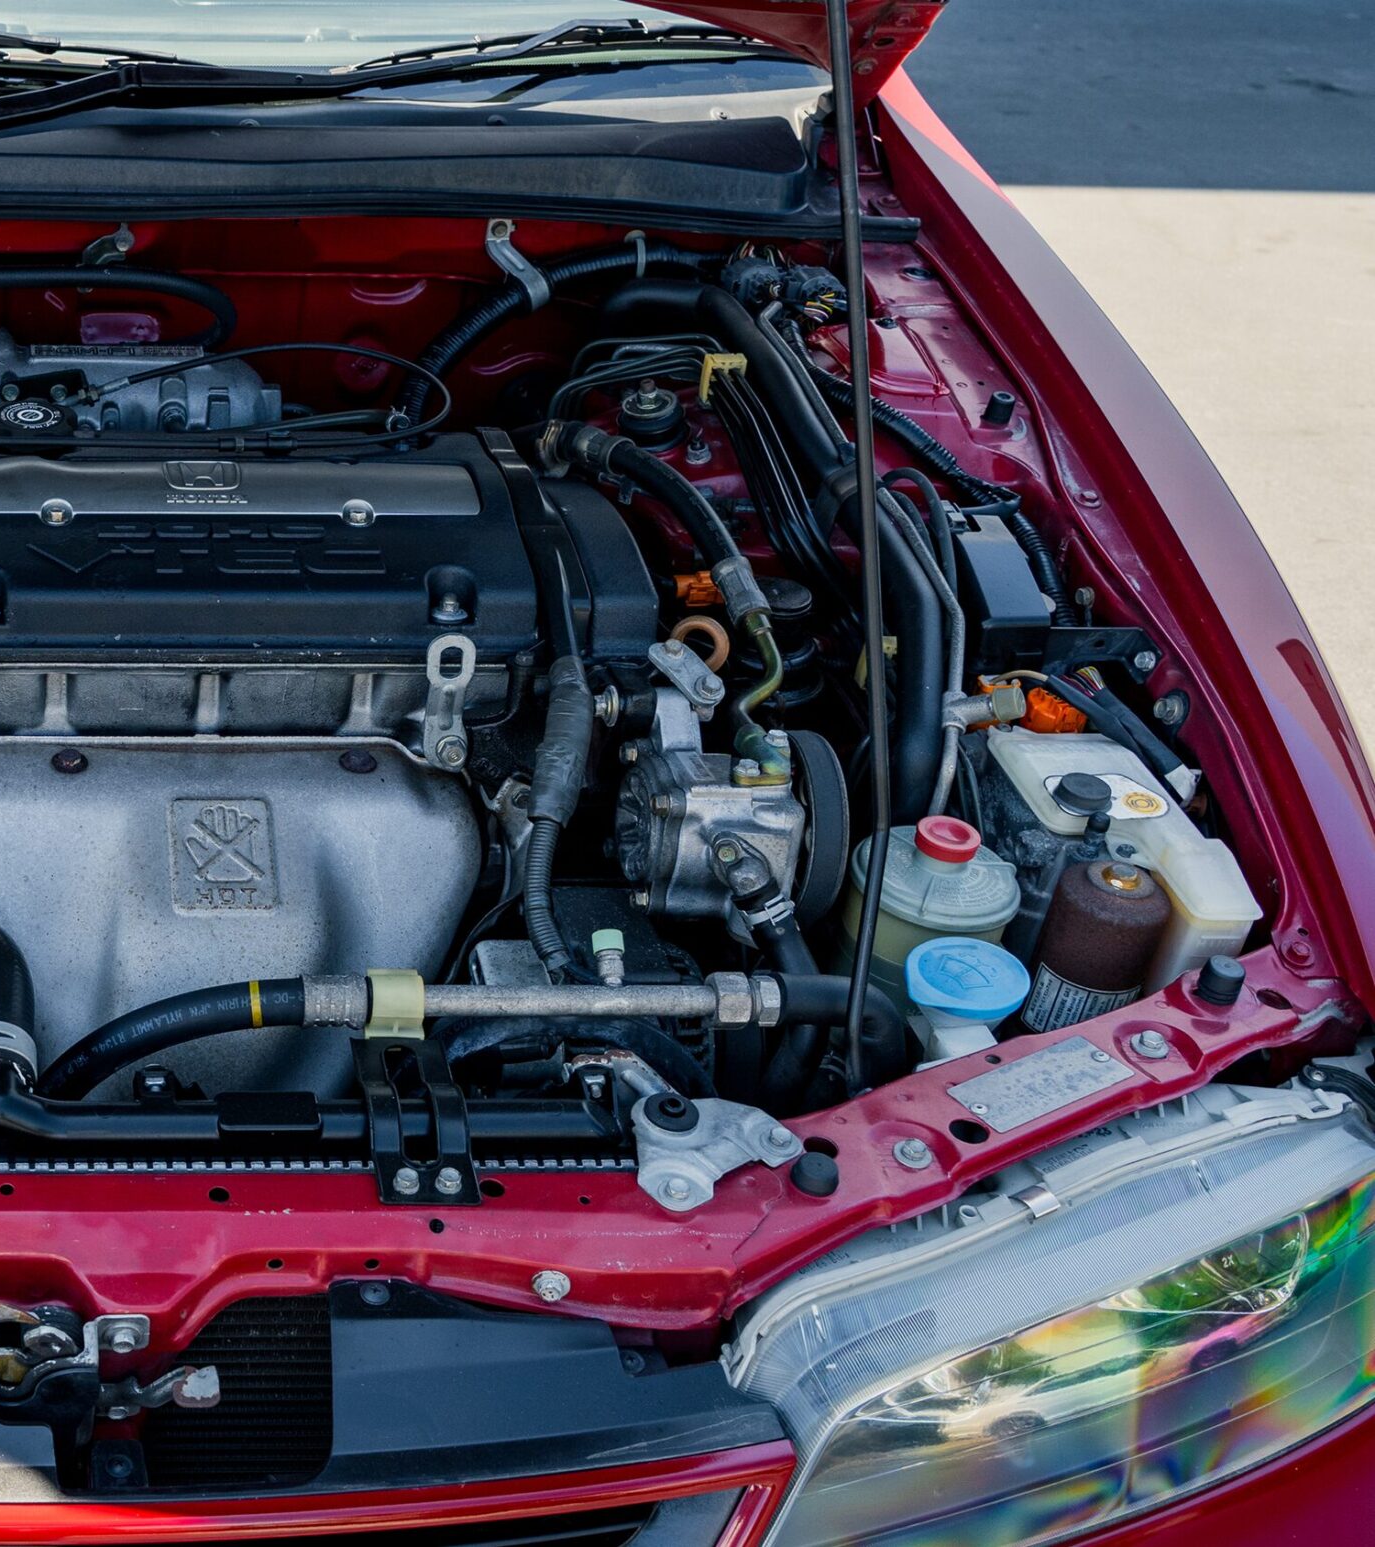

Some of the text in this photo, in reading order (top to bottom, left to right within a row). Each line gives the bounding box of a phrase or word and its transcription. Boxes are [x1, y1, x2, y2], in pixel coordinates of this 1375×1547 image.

[166, 494, 247, 504] HONDA
[97, 522, 325, 539] DOHC
[25, 543, 386, 574] VTEC
[196, 887, 257, 905] HOT
